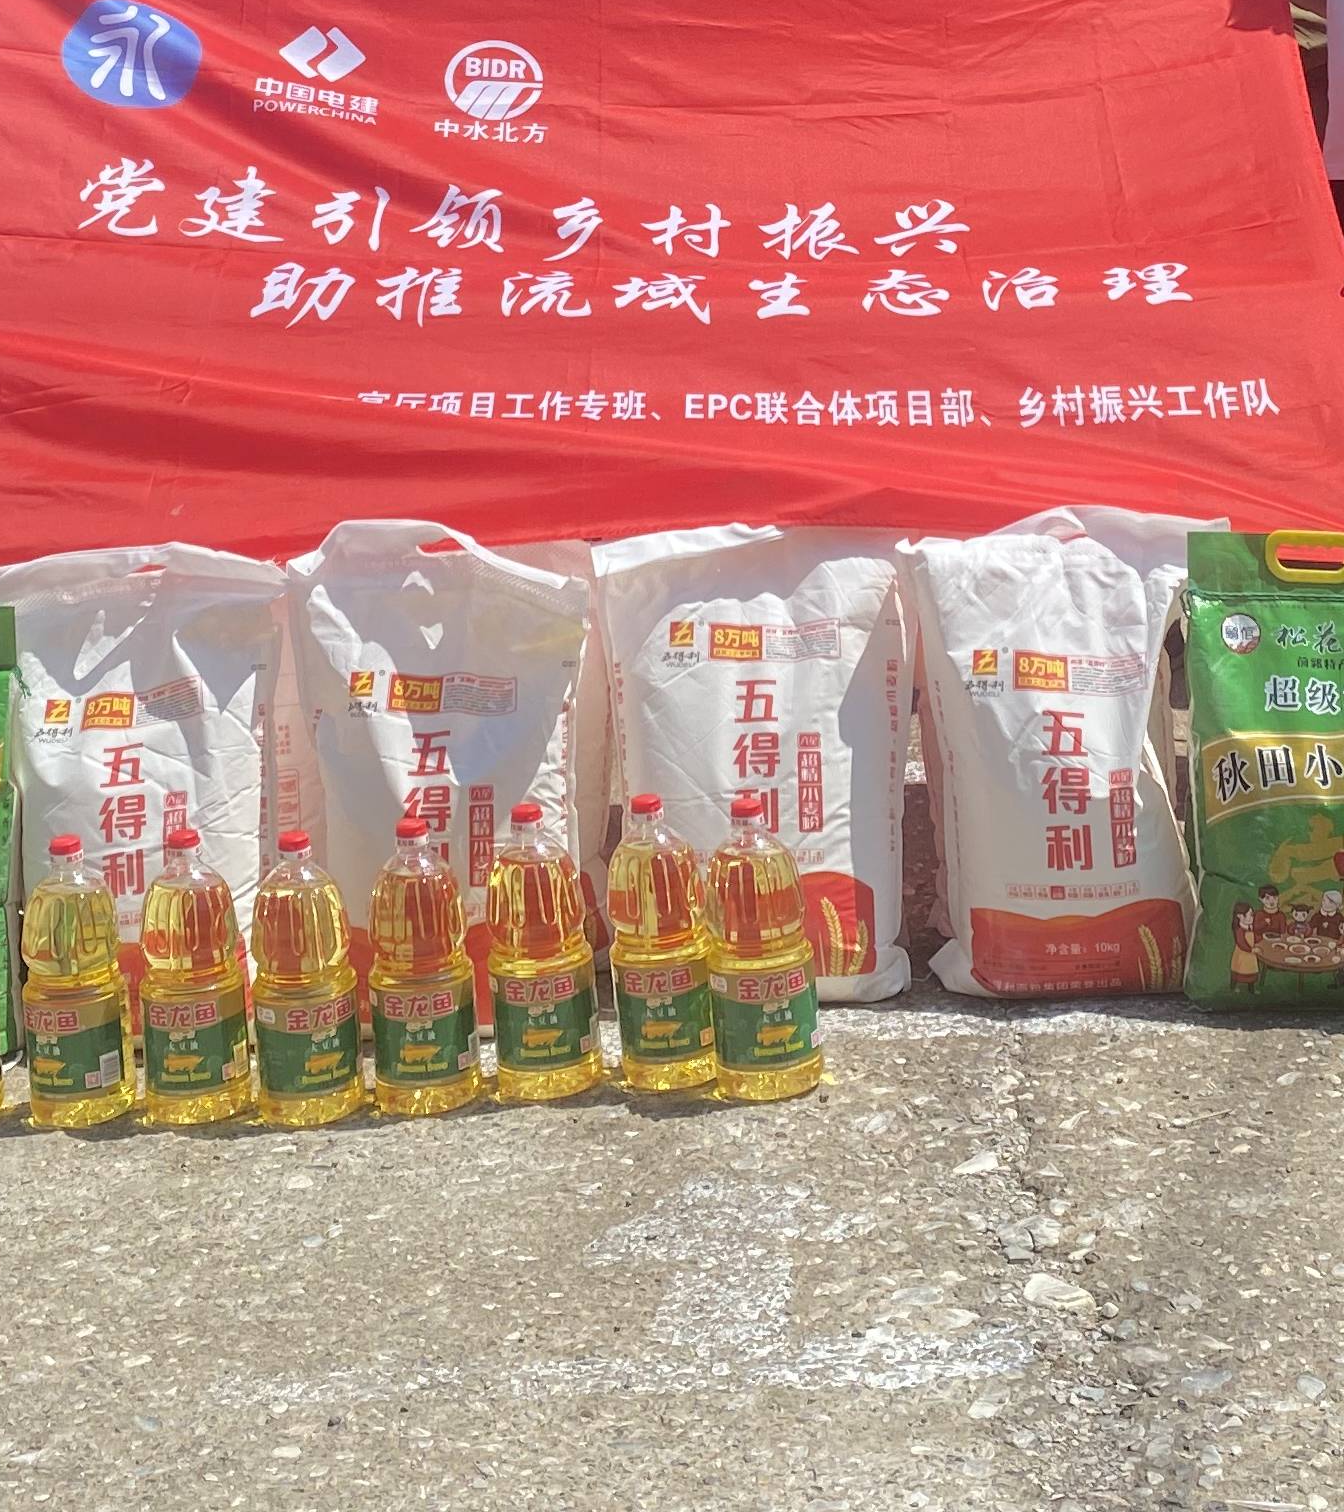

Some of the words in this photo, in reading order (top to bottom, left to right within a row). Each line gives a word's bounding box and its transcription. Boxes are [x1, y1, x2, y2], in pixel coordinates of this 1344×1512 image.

[465, 56, 528, 80] BIDR
[254, 76, 380, 117] 中国电建
[252, 98, 378, 126] POWERCHINA
[433, 118, 549, 144] 中水北方
[77, 156, 971, 262] 党建引领乡村振兴
[248, 260, 1196, 328] 助推流域生态治理
[713, 628, 760, 648] 8万吨
[1018, 656, 1065, 678] 8万吨
[86, 696, 132, 716] 8万吨
[403, 730, 452, 864] 五得
[1040, 708, 1093, 873] 五得利
[99, 742, 148, 898] 五得利
[1094, 942, 1121, 955] 10kg
[504, 975, 576, 1006] 金龙鱼
[622, 968, 693, 995] 金龙鱼
[736, 967, 807, 1003] 金龙鱼
[147, 1001, 219, 1030] 金龙鱼
[285, 994, 354, 1034] 金龙鱼
[382, 990, 457, 1020] 金龙鱼
